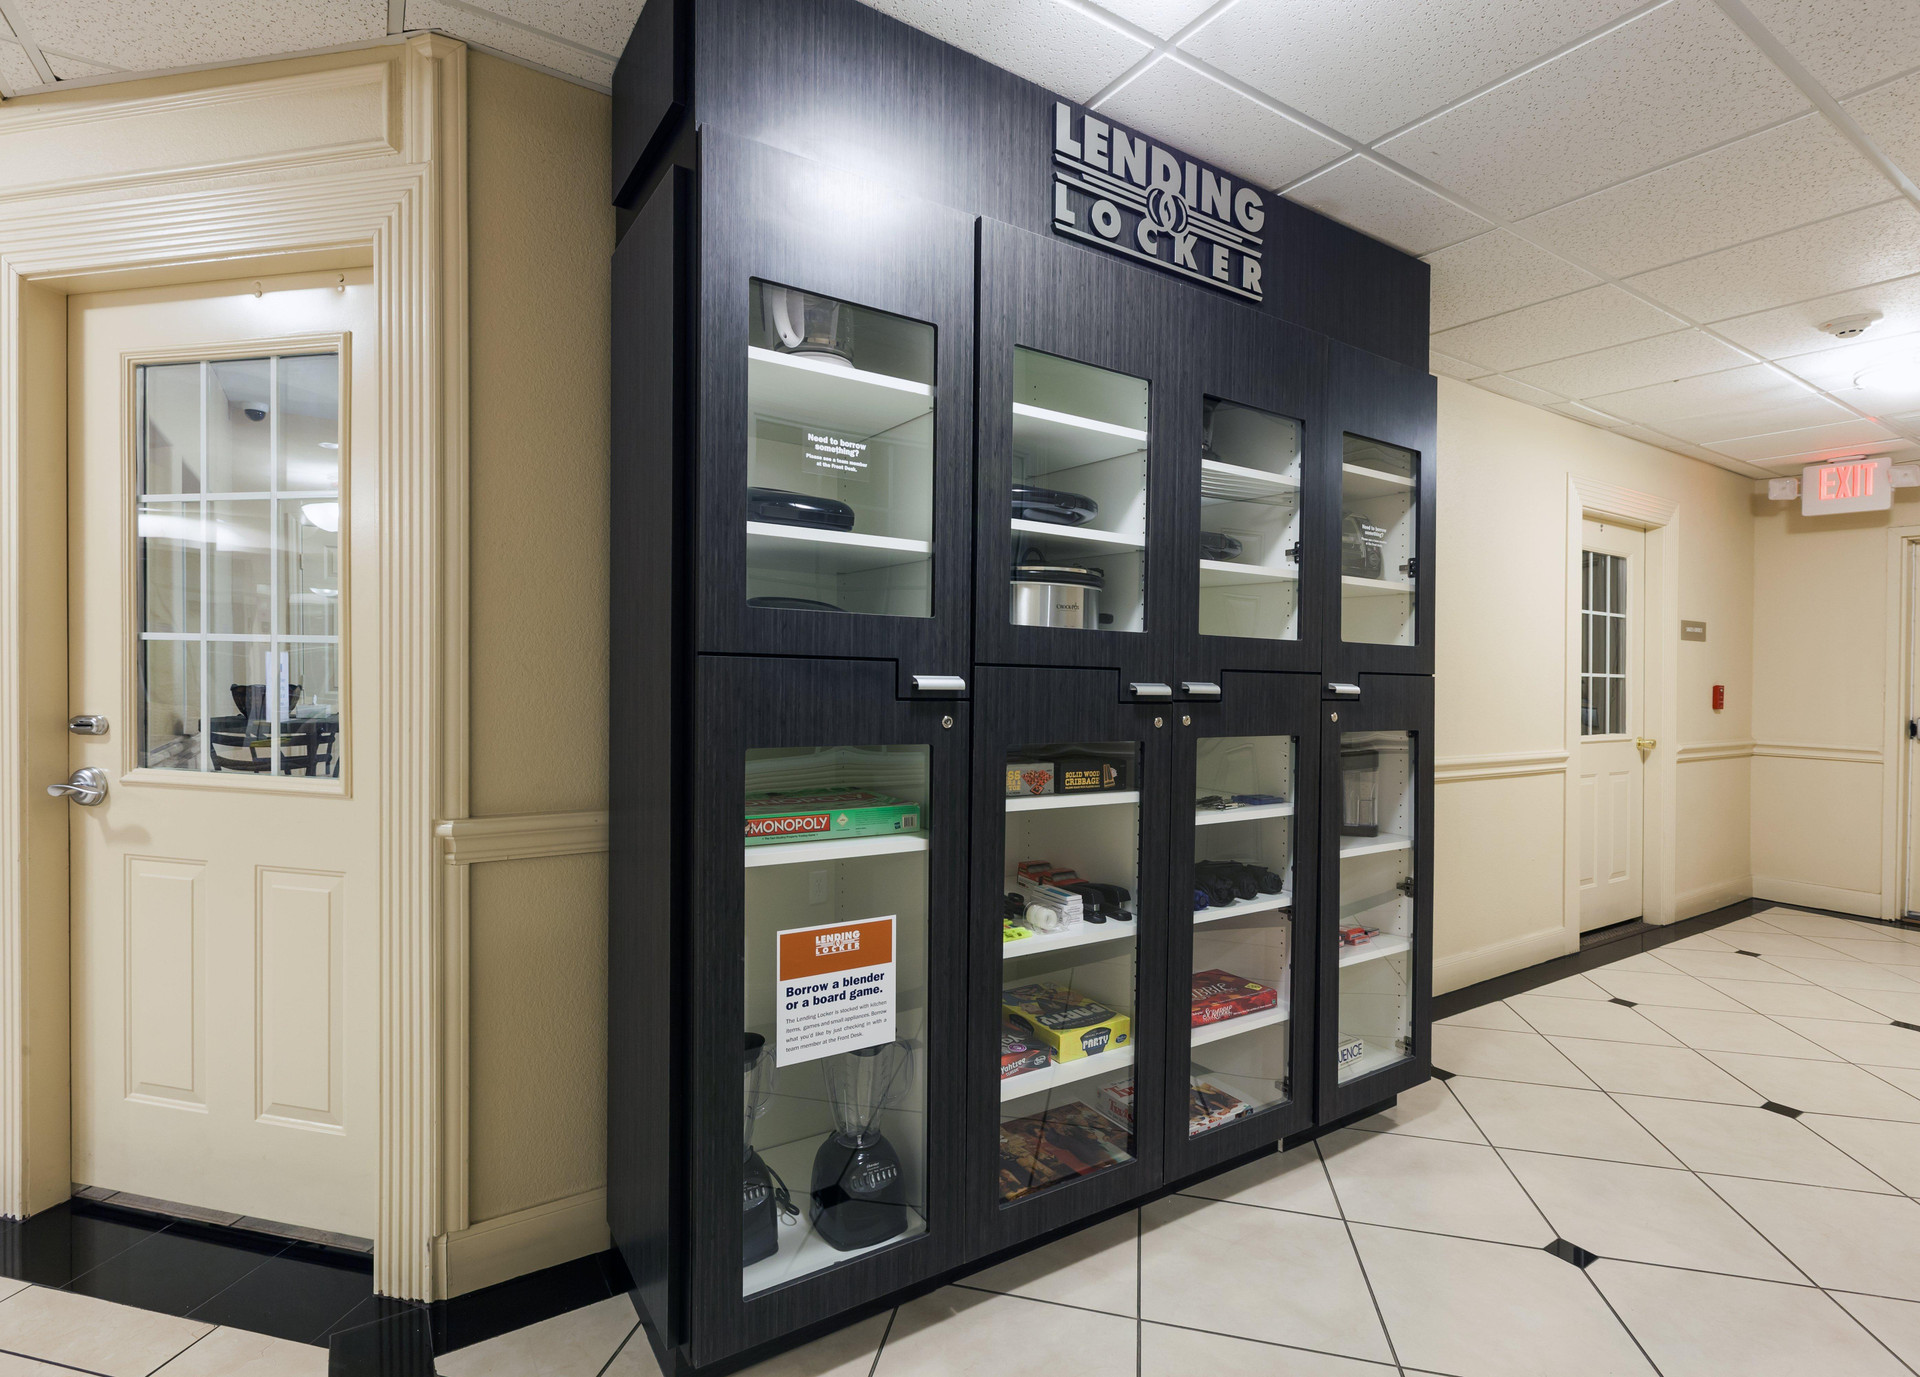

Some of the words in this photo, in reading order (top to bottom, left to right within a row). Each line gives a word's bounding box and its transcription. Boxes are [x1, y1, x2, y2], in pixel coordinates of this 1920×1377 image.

[1055, 101, 1265, 233] LENDING
[1055, 181, 1263, 294] LOCKER
[808, 433, 828, 444] Need
[830, 437, 838, 445] to
[840, 439, 866, 450] borrow
[815, 444, 859, 457] something?
[1819, 462, 1877, 500] EXIT
[1065, 777, 1100, 786] CRIBBAGE
[750, 816, 828, 834] MONOPOLY
[815, 930, 860, 944] LENDING
[815, 942, 860, 955] LOCKER
[786, 982, 828, 997] Borrow
[832, 981, 839, 989] a
[842, 972, 885, 987] blender
[786, 1000, 799, 1010] or
[802, 1000, 809, 1008] a
[813, 991, 846, 1006] board
[849, 986, 883, 1001] game.
[797, 1014, 816, 1022] Lending
[803, 1023, 820, 1031] games
[844, 1023, 865, 1031] checking
[800, 1041, 822, 1049] member
[1083, 1035, 1108, 1049] PARTY
